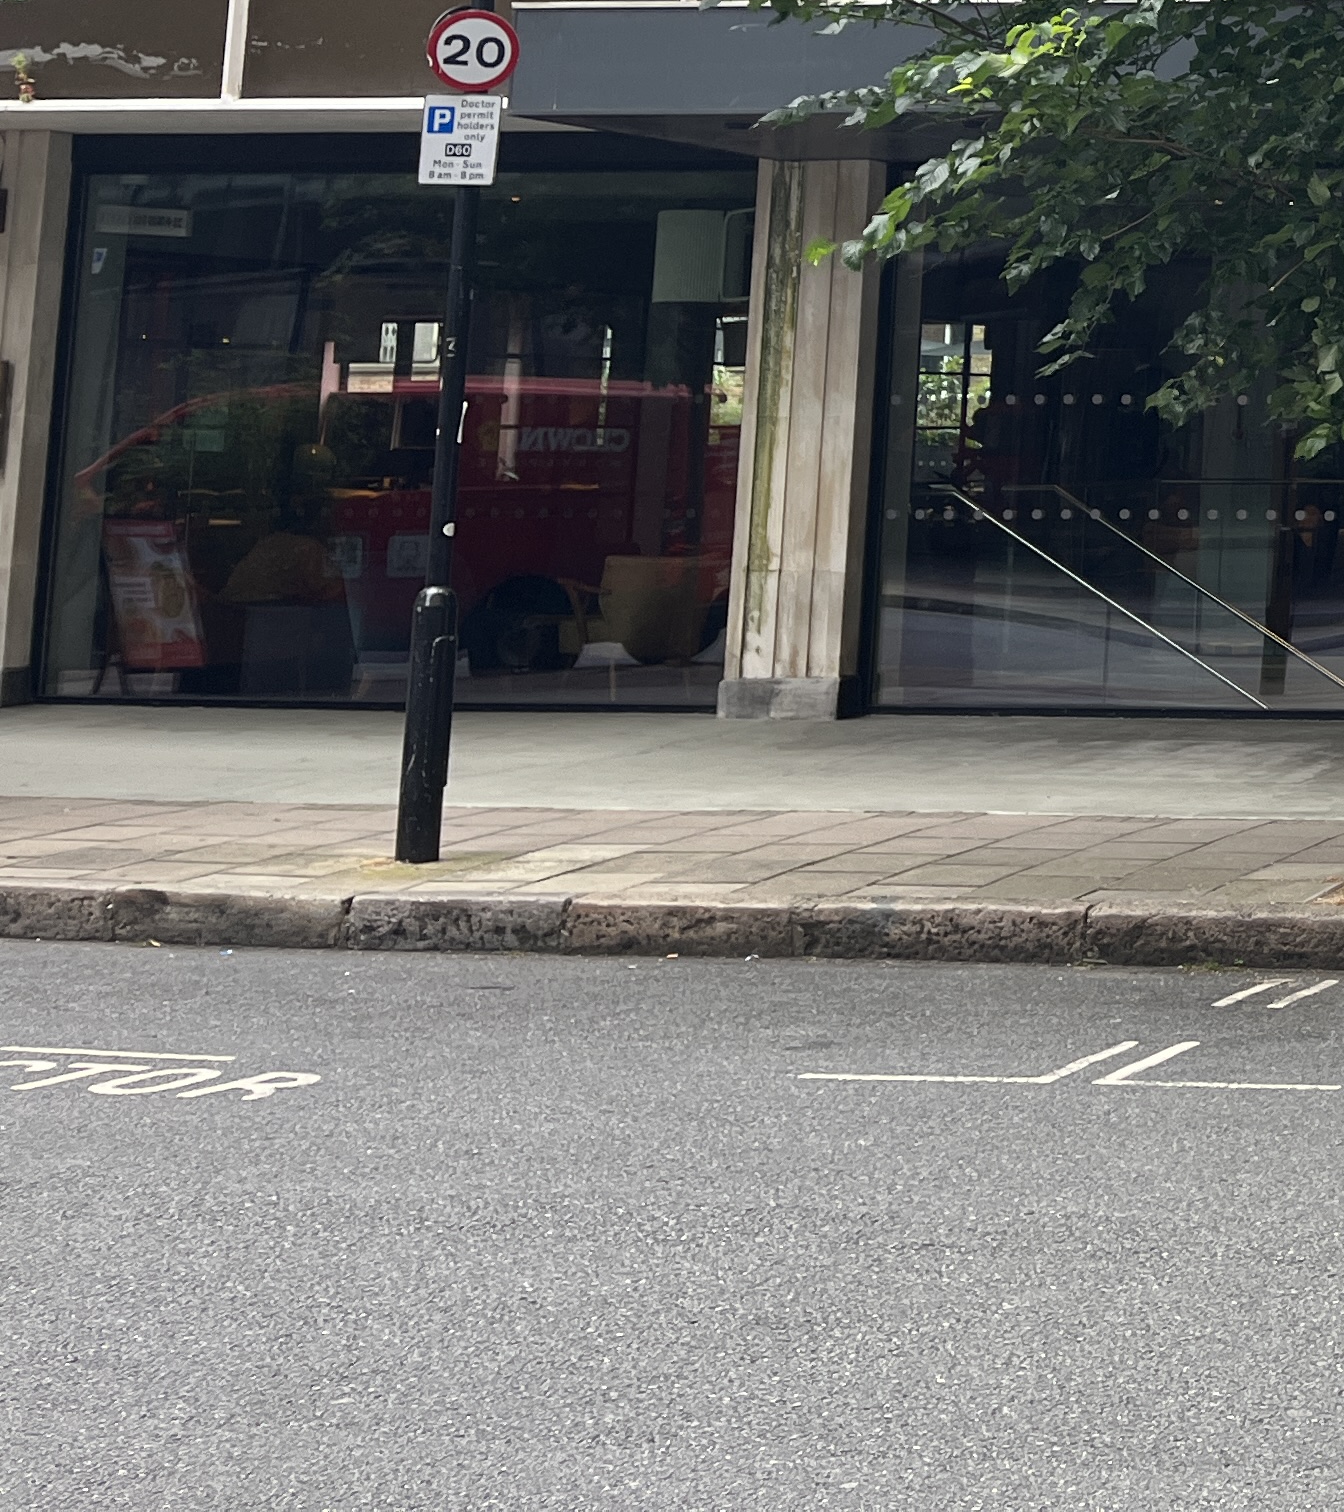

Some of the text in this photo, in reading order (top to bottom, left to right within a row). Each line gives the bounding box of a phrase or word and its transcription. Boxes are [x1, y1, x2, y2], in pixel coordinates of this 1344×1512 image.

[443, 34, 505, 68] 20
[461, 99, 496, 108] Doctor
[433, 109, 452, 131] P
[460, 111, 494, 121] permit
[457, 122, 495, 131] holders
[464, 133, 486, 142] only
[433, 159, 454, 168] Mon
[463, 160, 482, 169] Sun
